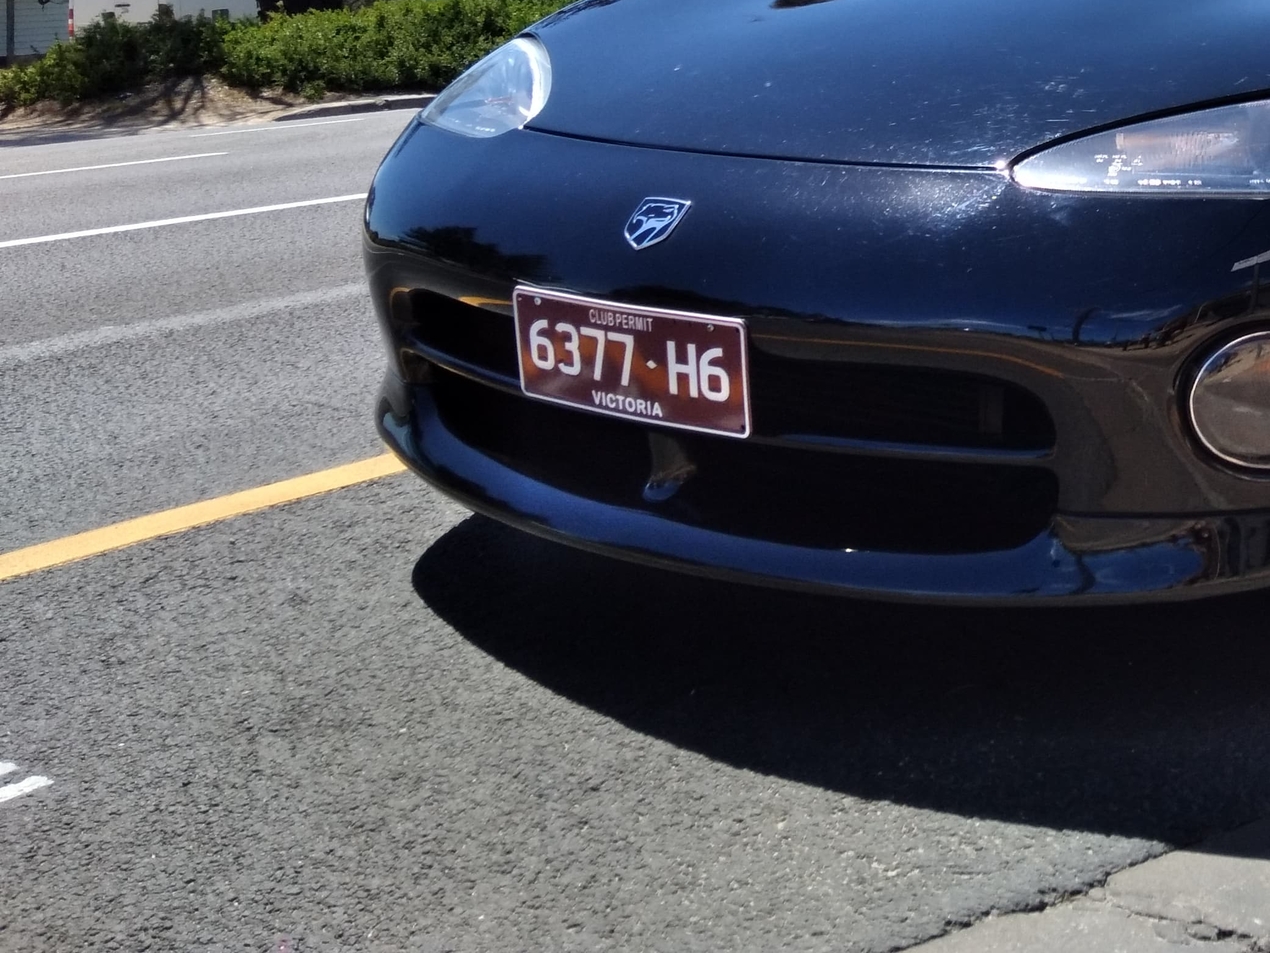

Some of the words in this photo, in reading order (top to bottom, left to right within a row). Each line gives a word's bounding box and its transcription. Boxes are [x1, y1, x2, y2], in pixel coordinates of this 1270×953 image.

[589, 309, 615, 326] CLUB
[616, 314, 653, 333] PERMIT
[529, 319, 635, 387] 6377
[666, 340, 731, 402] H6
[591, 389, 663, 418] VICTORIA
